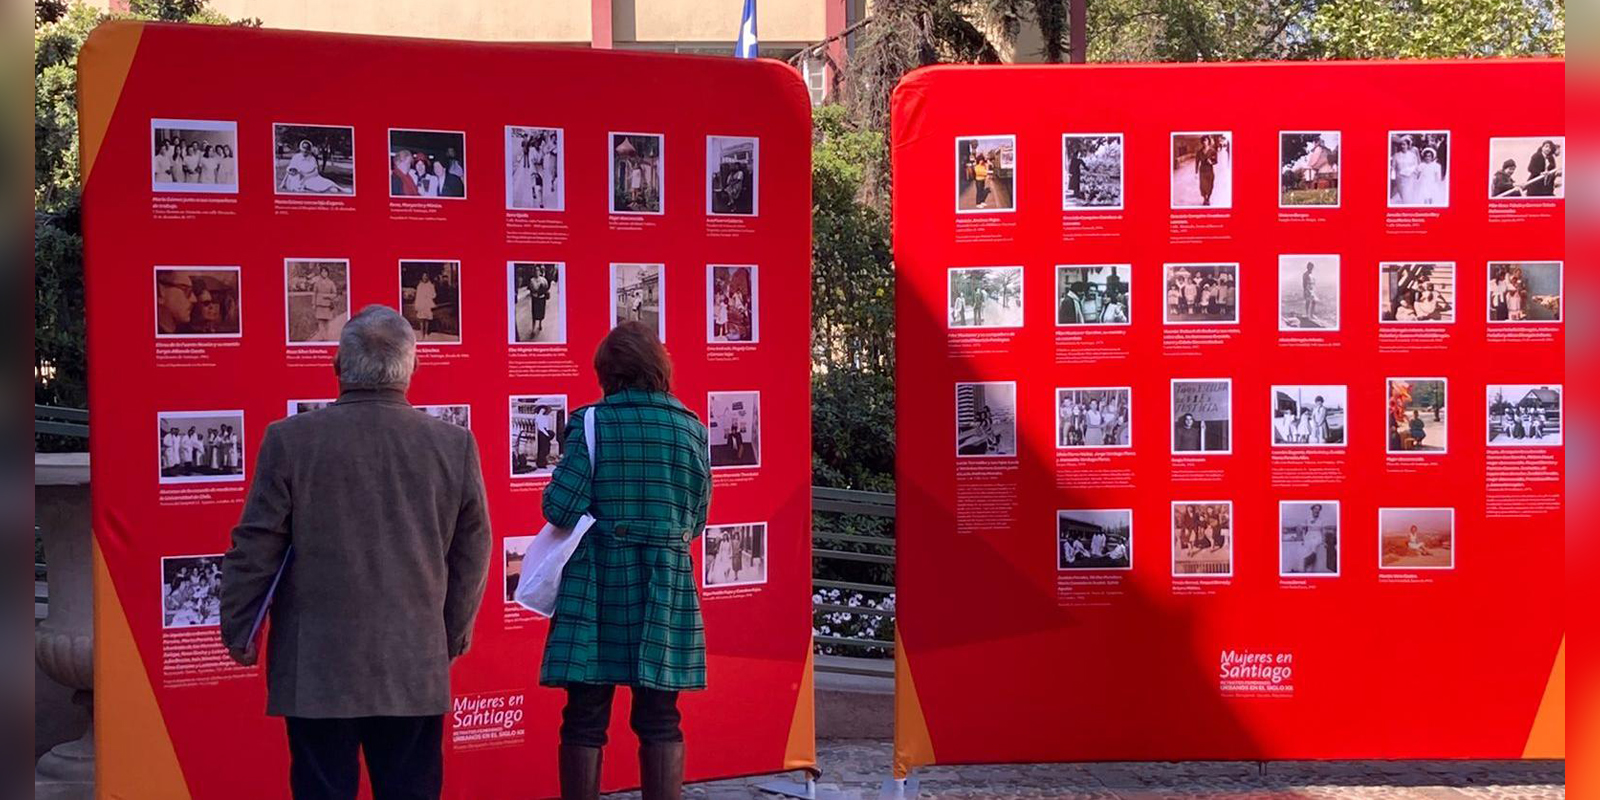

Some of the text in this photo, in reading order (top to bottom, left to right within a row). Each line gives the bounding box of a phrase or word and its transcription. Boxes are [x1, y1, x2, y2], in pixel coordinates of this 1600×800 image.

[1220, 649, 1293, 668] Mujeres en
[1219, 662, 1292, 684] Santiago
[453, 694, 524, 714] Mujeres en
[452, 709, 523, 728] Santiago
